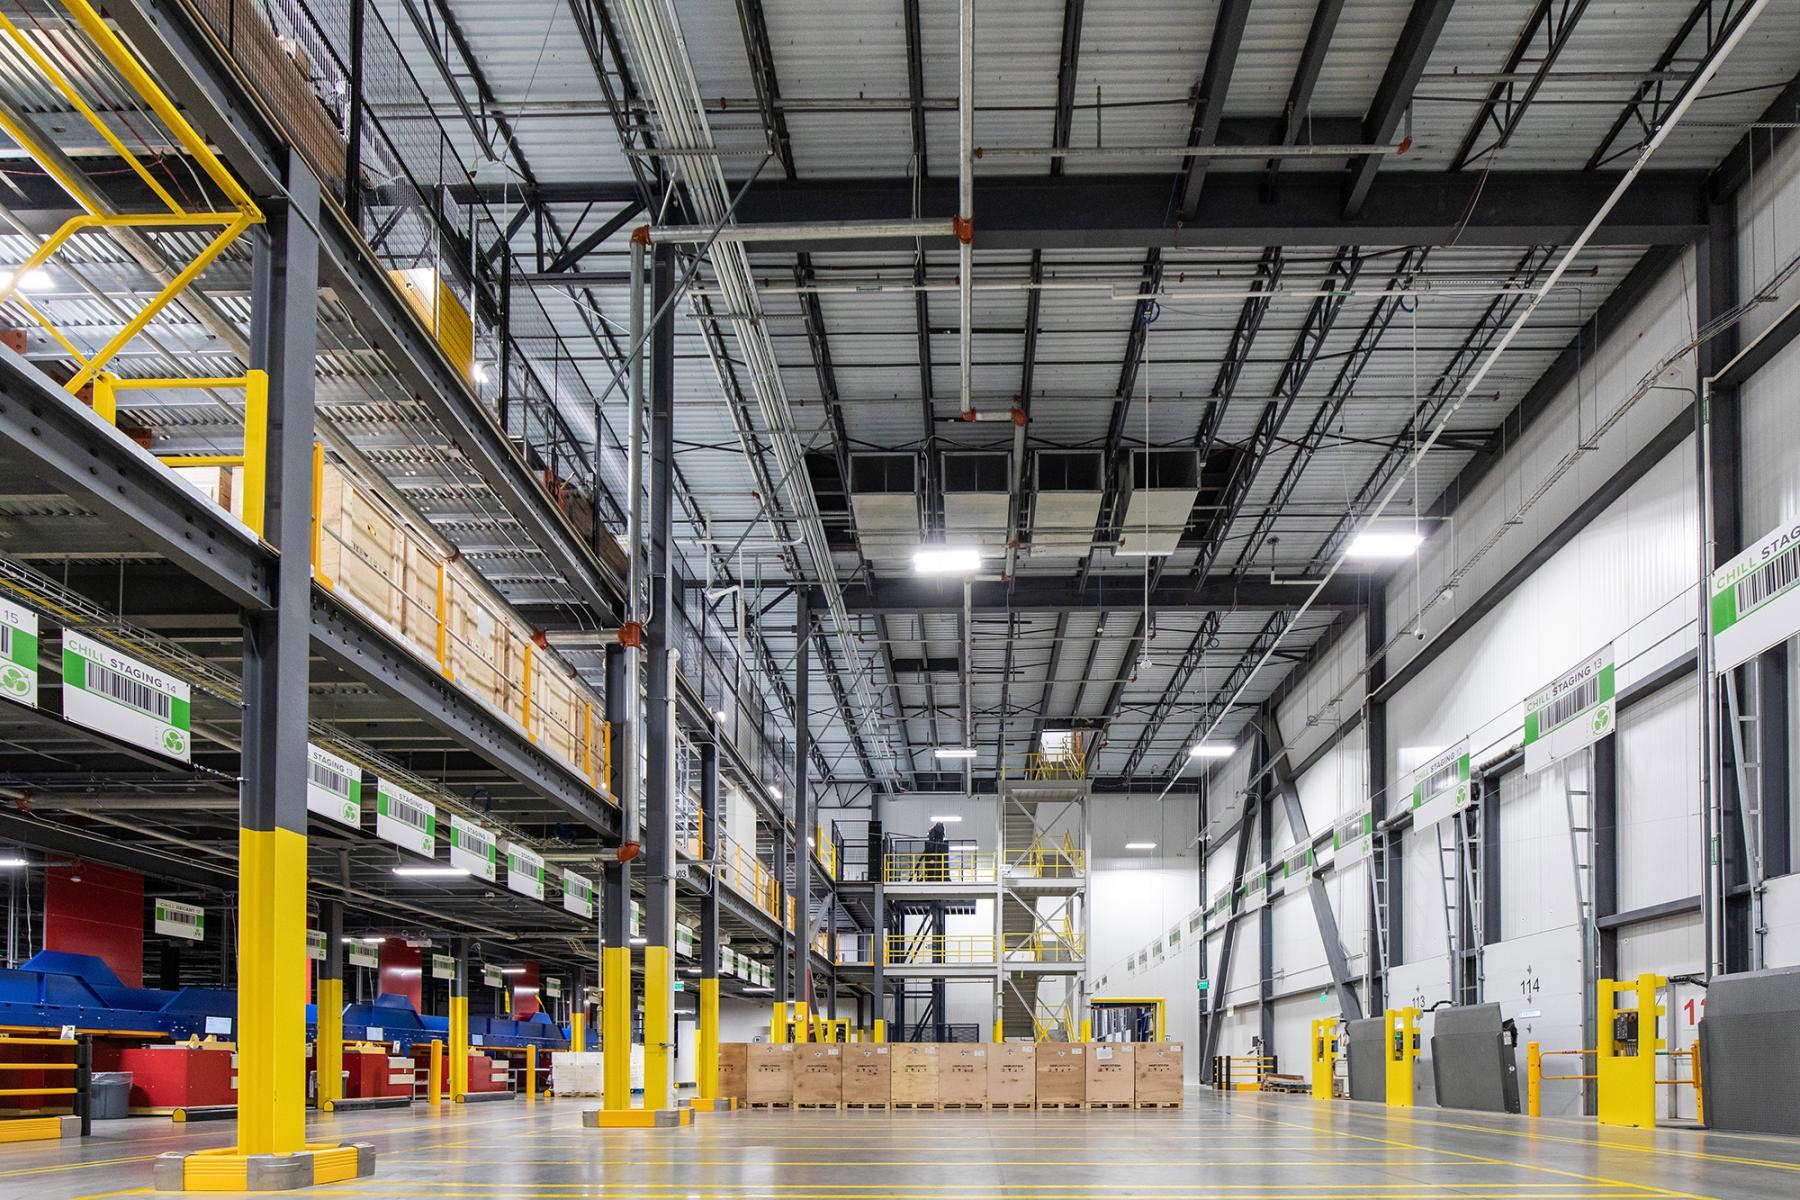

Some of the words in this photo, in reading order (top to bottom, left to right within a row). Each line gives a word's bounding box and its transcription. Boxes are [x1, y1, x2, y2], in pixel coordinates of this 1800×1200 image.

[1717, 557, 1757, 589] CHILL
[4, 610, 19, 624] 15
[69, 640, 106, 663] CHILL
[110, 658, 162, 688] STAGING
[166, 683, 177, 694] 14
[1527, 693, 1550, 711] CHILL
[1552, 666, 1591, 696] STAGING
[1594, 658, 1602, 670] 13
[313, 752, 345, 772] STAGING
[1430, 752, 1455, 773] STAGING
[399, 793, 423, 810] STAGING
[1521, 977, 1540, 995] 114
[1412, 995, 1425, 1008] 113
